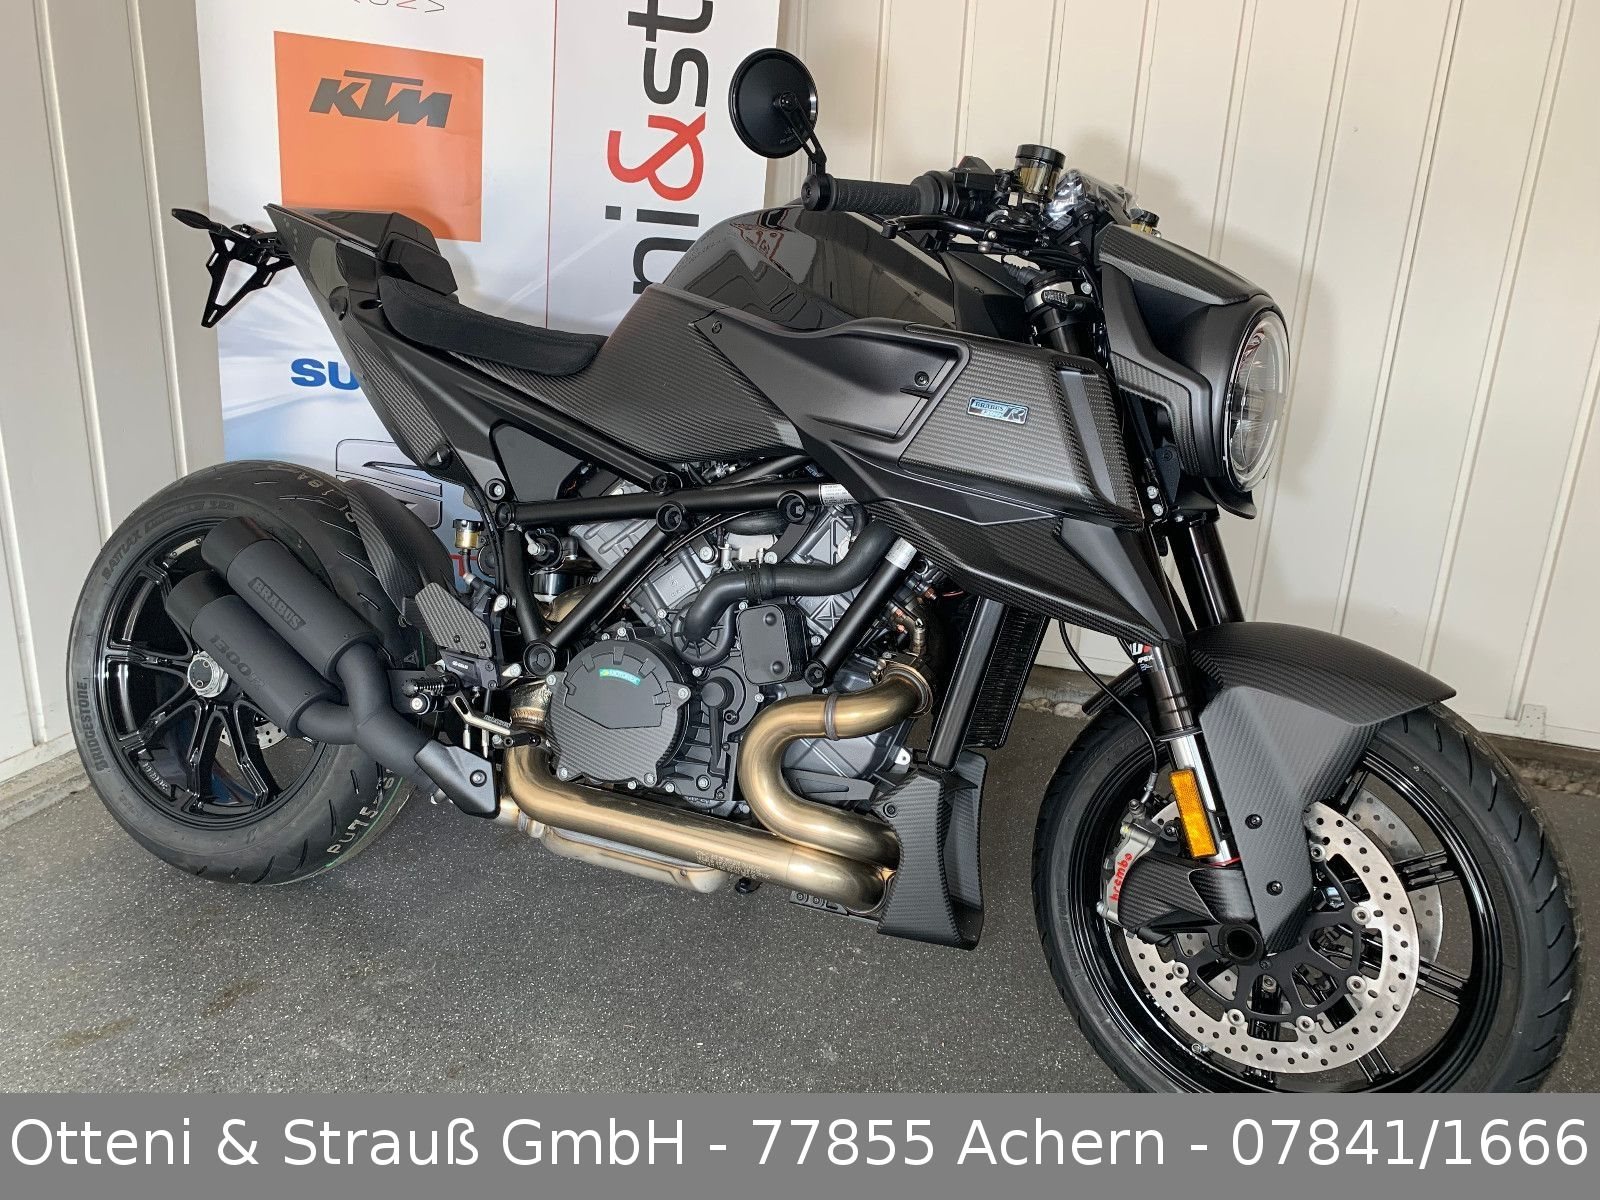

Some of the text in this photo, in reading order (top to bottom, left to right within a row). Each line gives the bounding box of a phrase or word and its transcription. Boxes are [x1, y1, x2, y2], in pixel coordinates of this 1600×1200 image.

[309, 70, 453, 128] KTM
[250, 579, 302, 630] BRABUS
[77, 680, 109, 773] BRIDGESTONE
[1109, 852, 1133, 901] brembo
